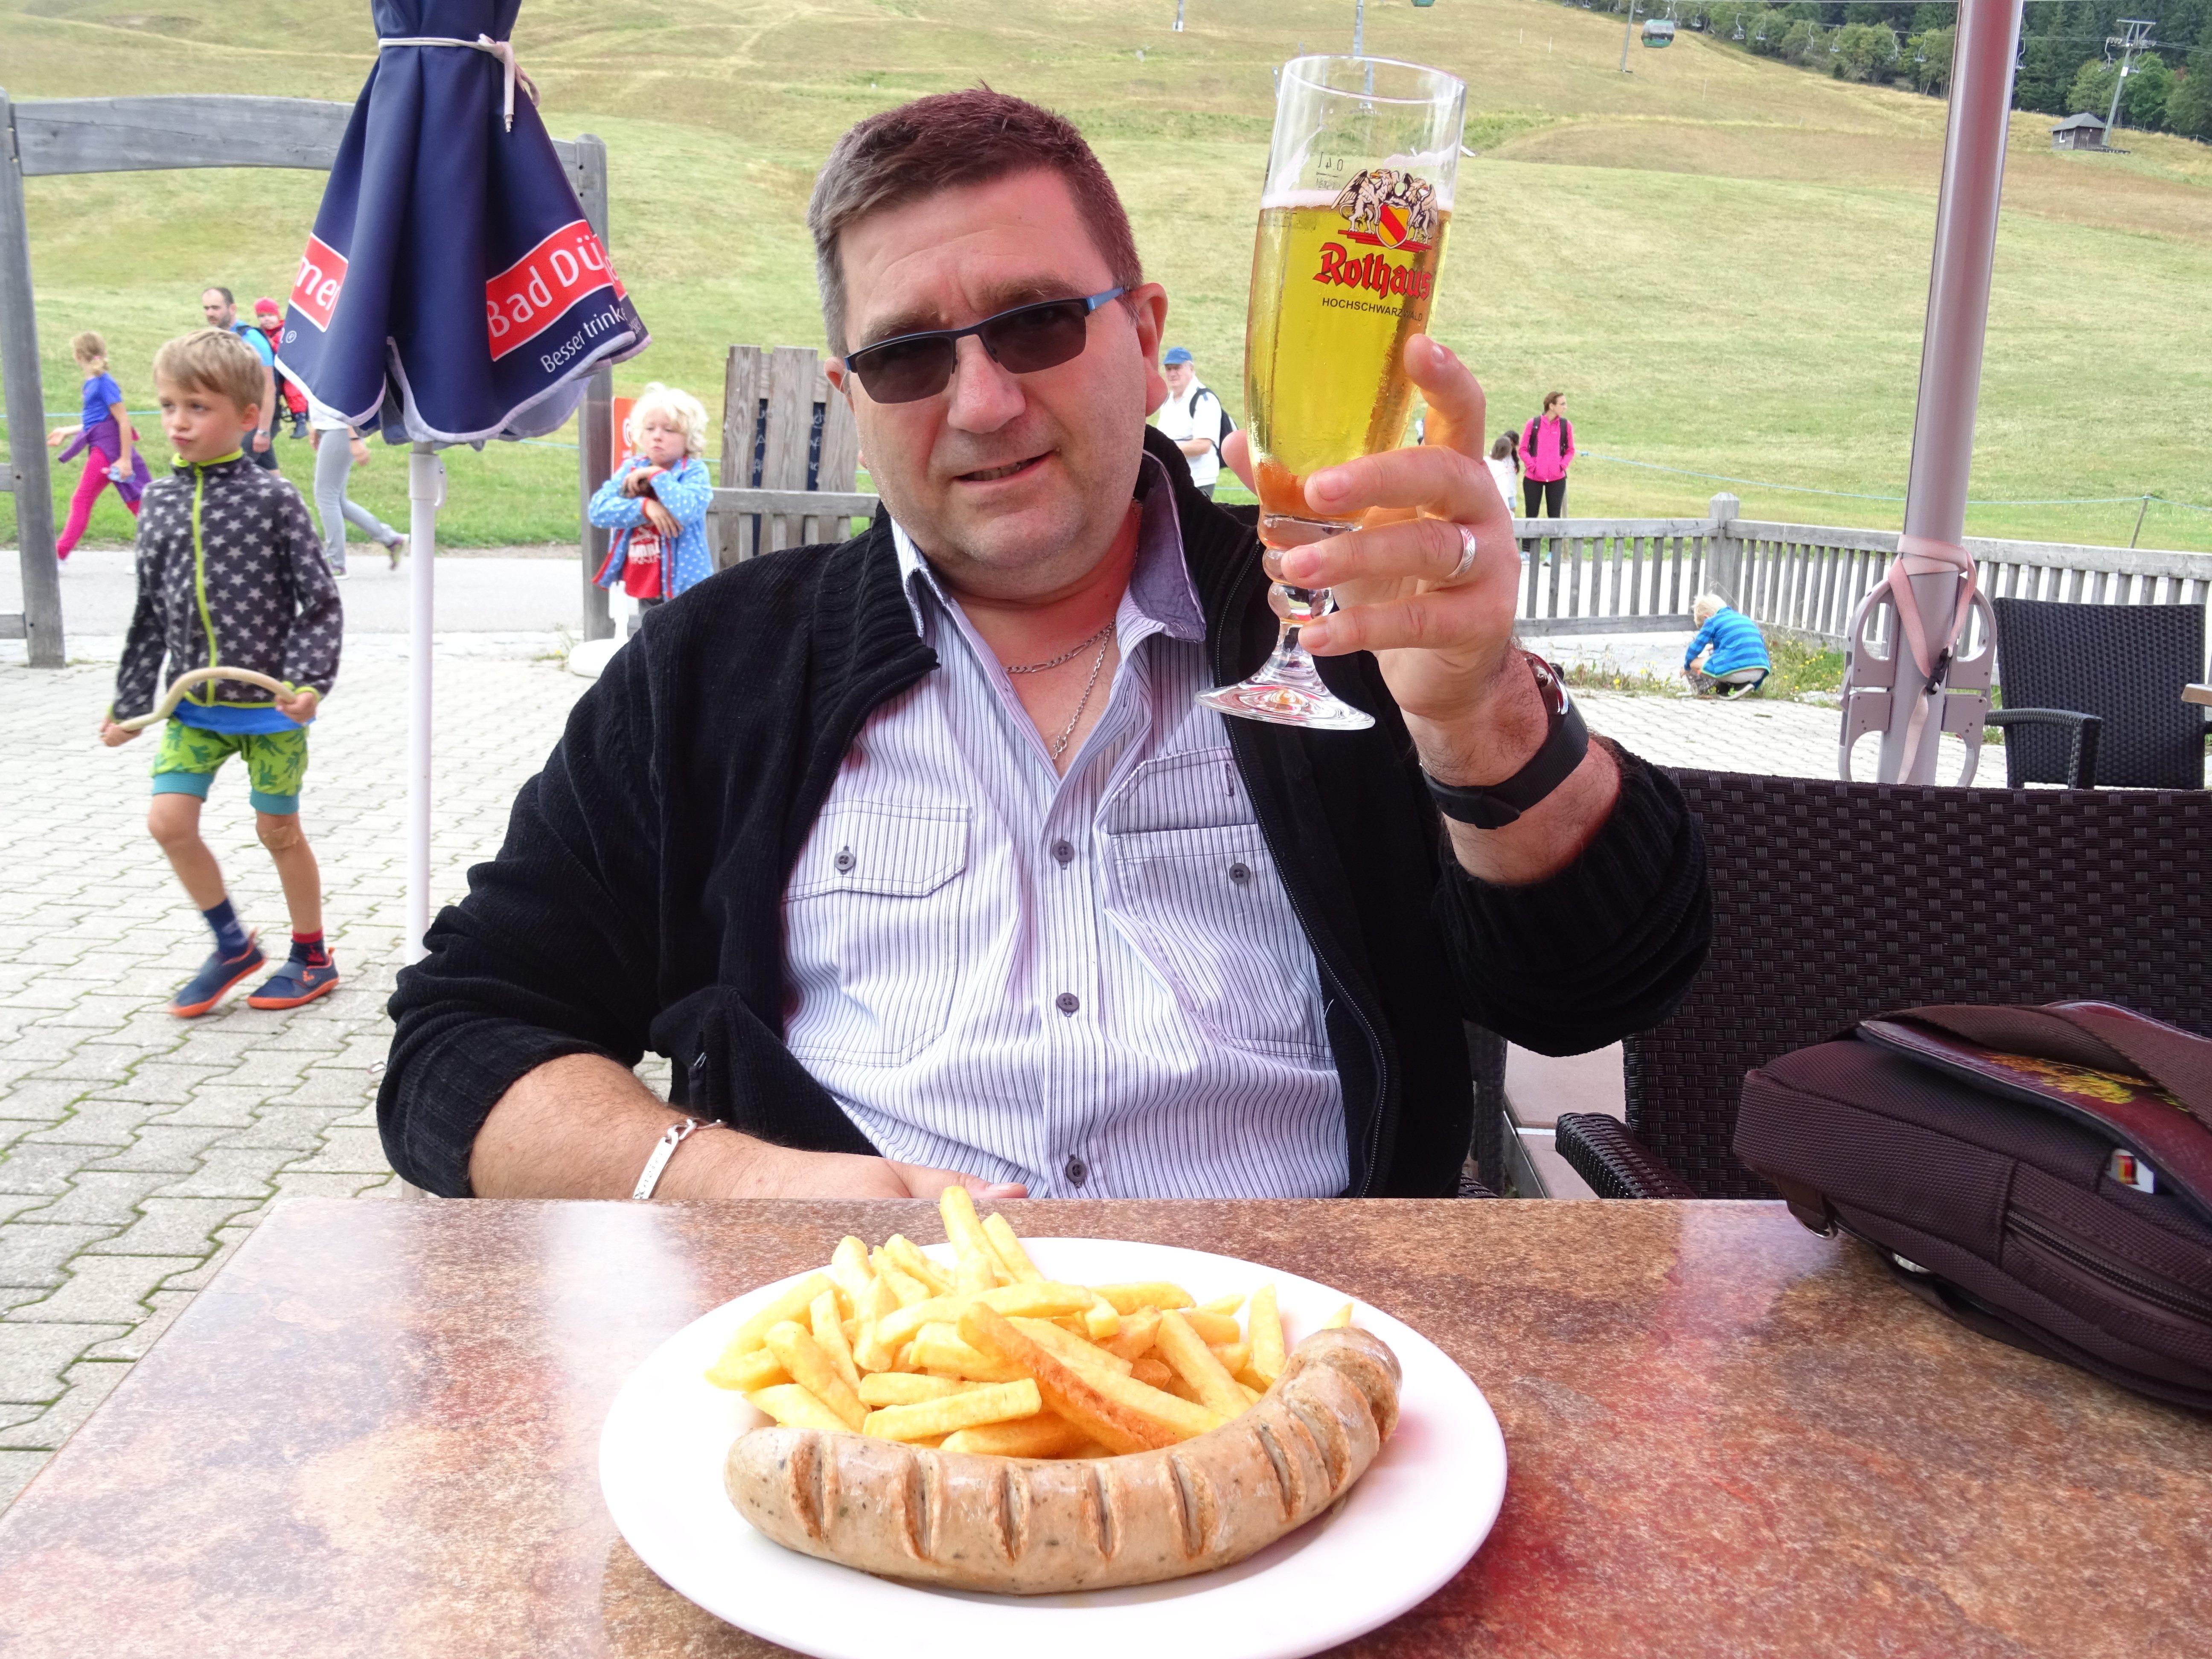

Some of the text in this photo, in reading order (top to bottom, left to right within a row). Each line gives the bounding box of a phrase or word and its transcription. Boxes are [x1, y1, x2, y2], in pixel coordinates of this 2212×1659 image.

[1312, 242, 1432, 301] Rothaus
[487, 265, 553, 338] Bad
[1322, 297, 1423, 322] HOCHSCHWARZWALD
[540, 331, 585, 373] Besser
